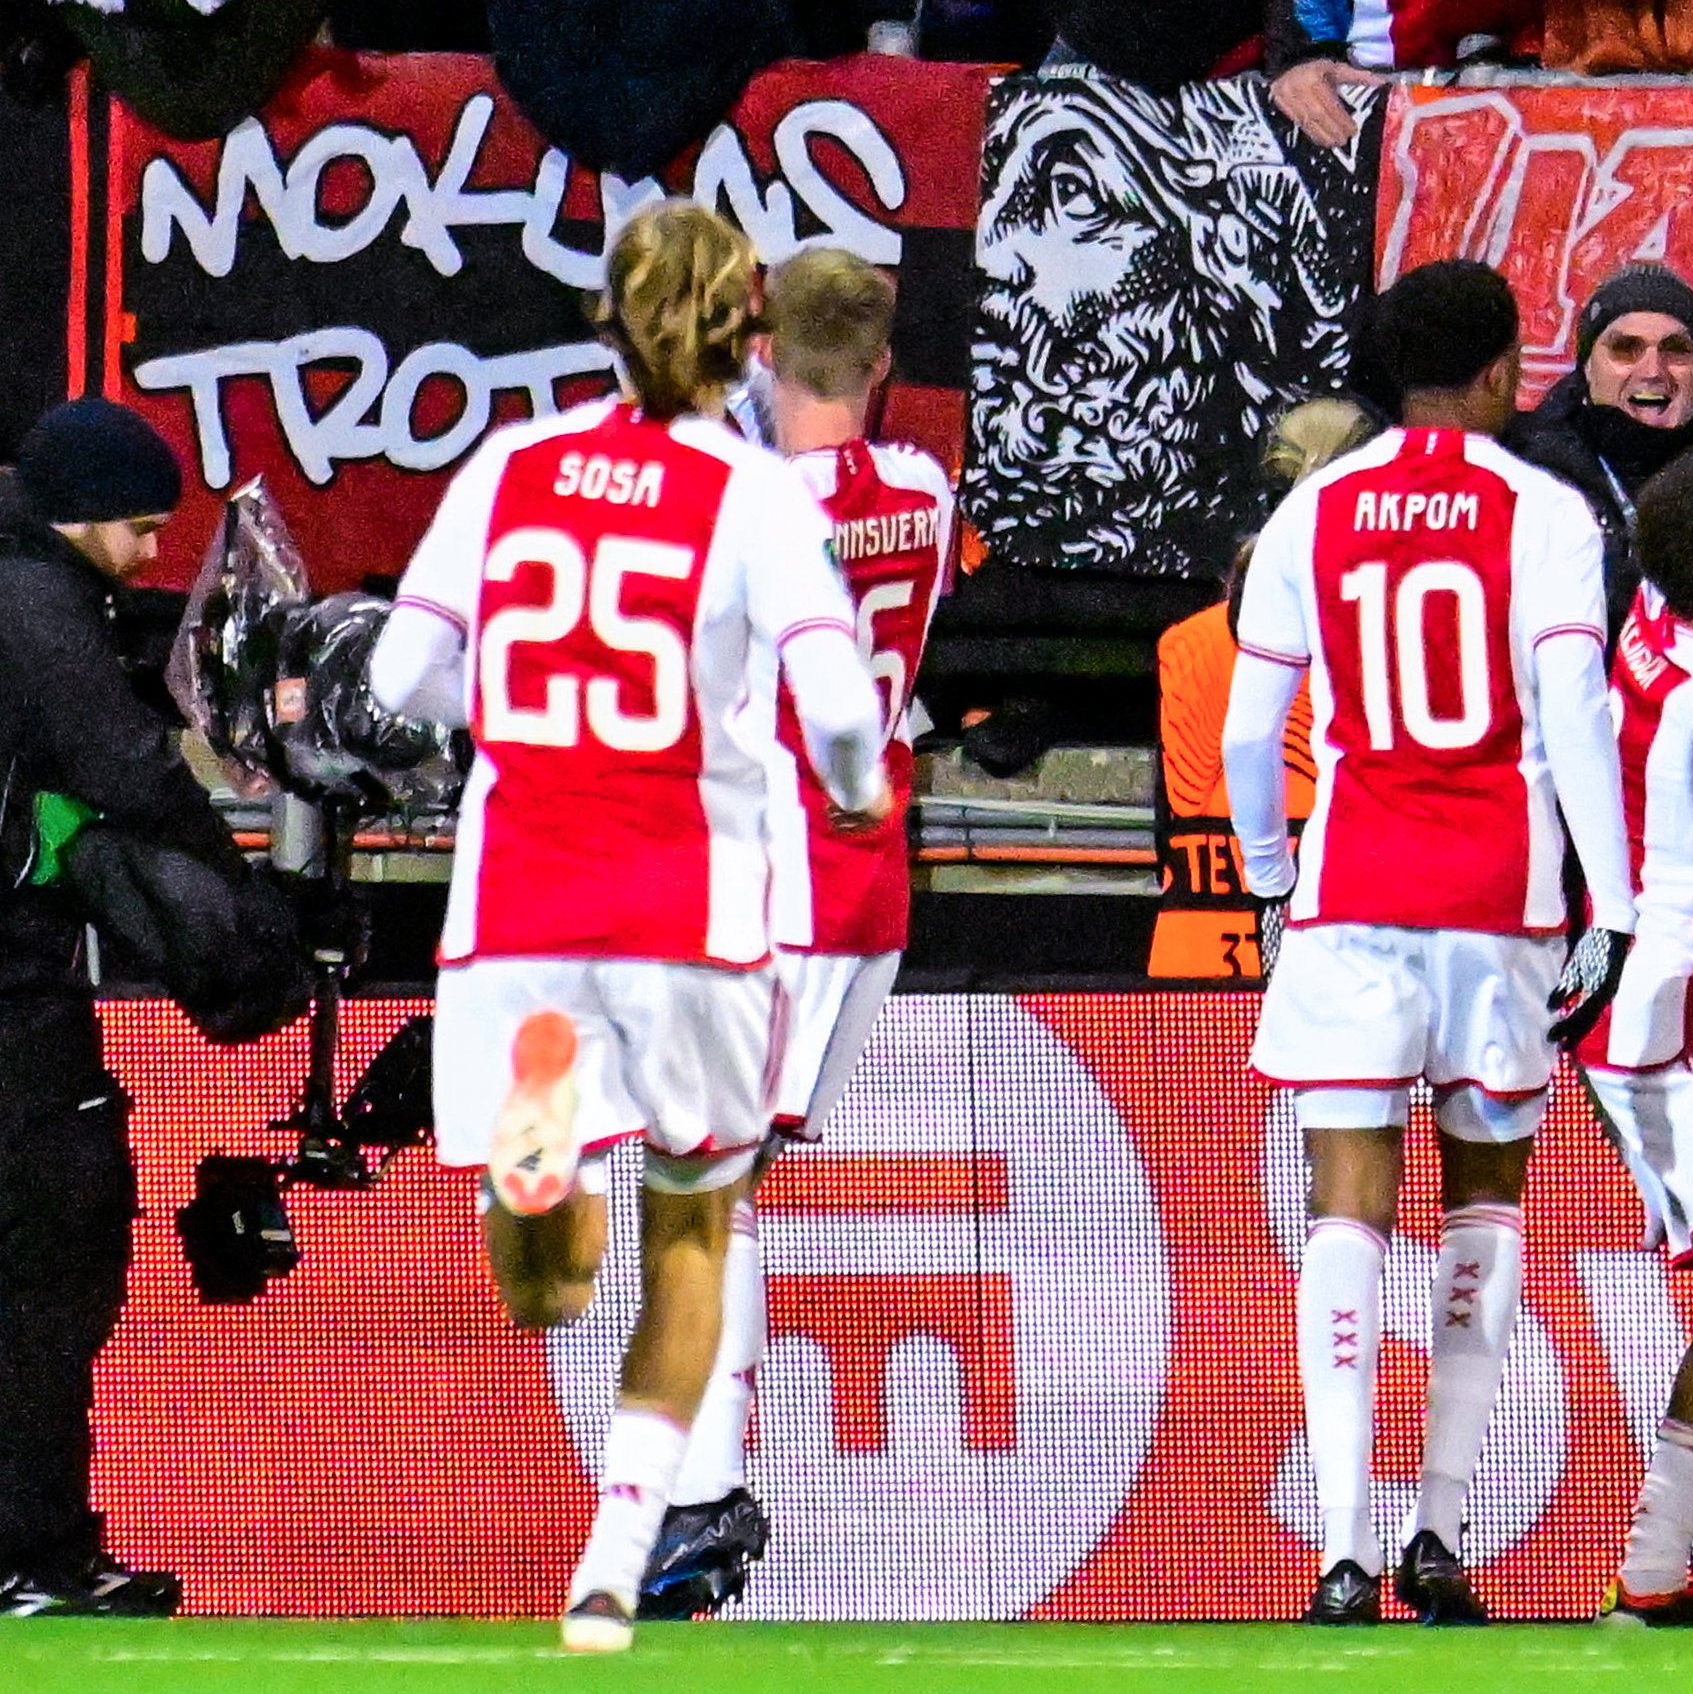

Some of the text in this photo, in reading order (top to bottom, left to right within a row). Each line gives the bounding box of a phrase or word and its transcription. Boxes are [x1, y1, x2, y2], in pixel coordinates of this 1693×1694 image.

[553, 452, 665, 509] SOSA
[1353, 489, 1480, 533] AKPOM
[478, 527, 698, 754] 25
[1340, 560, 1494, 753] 10
